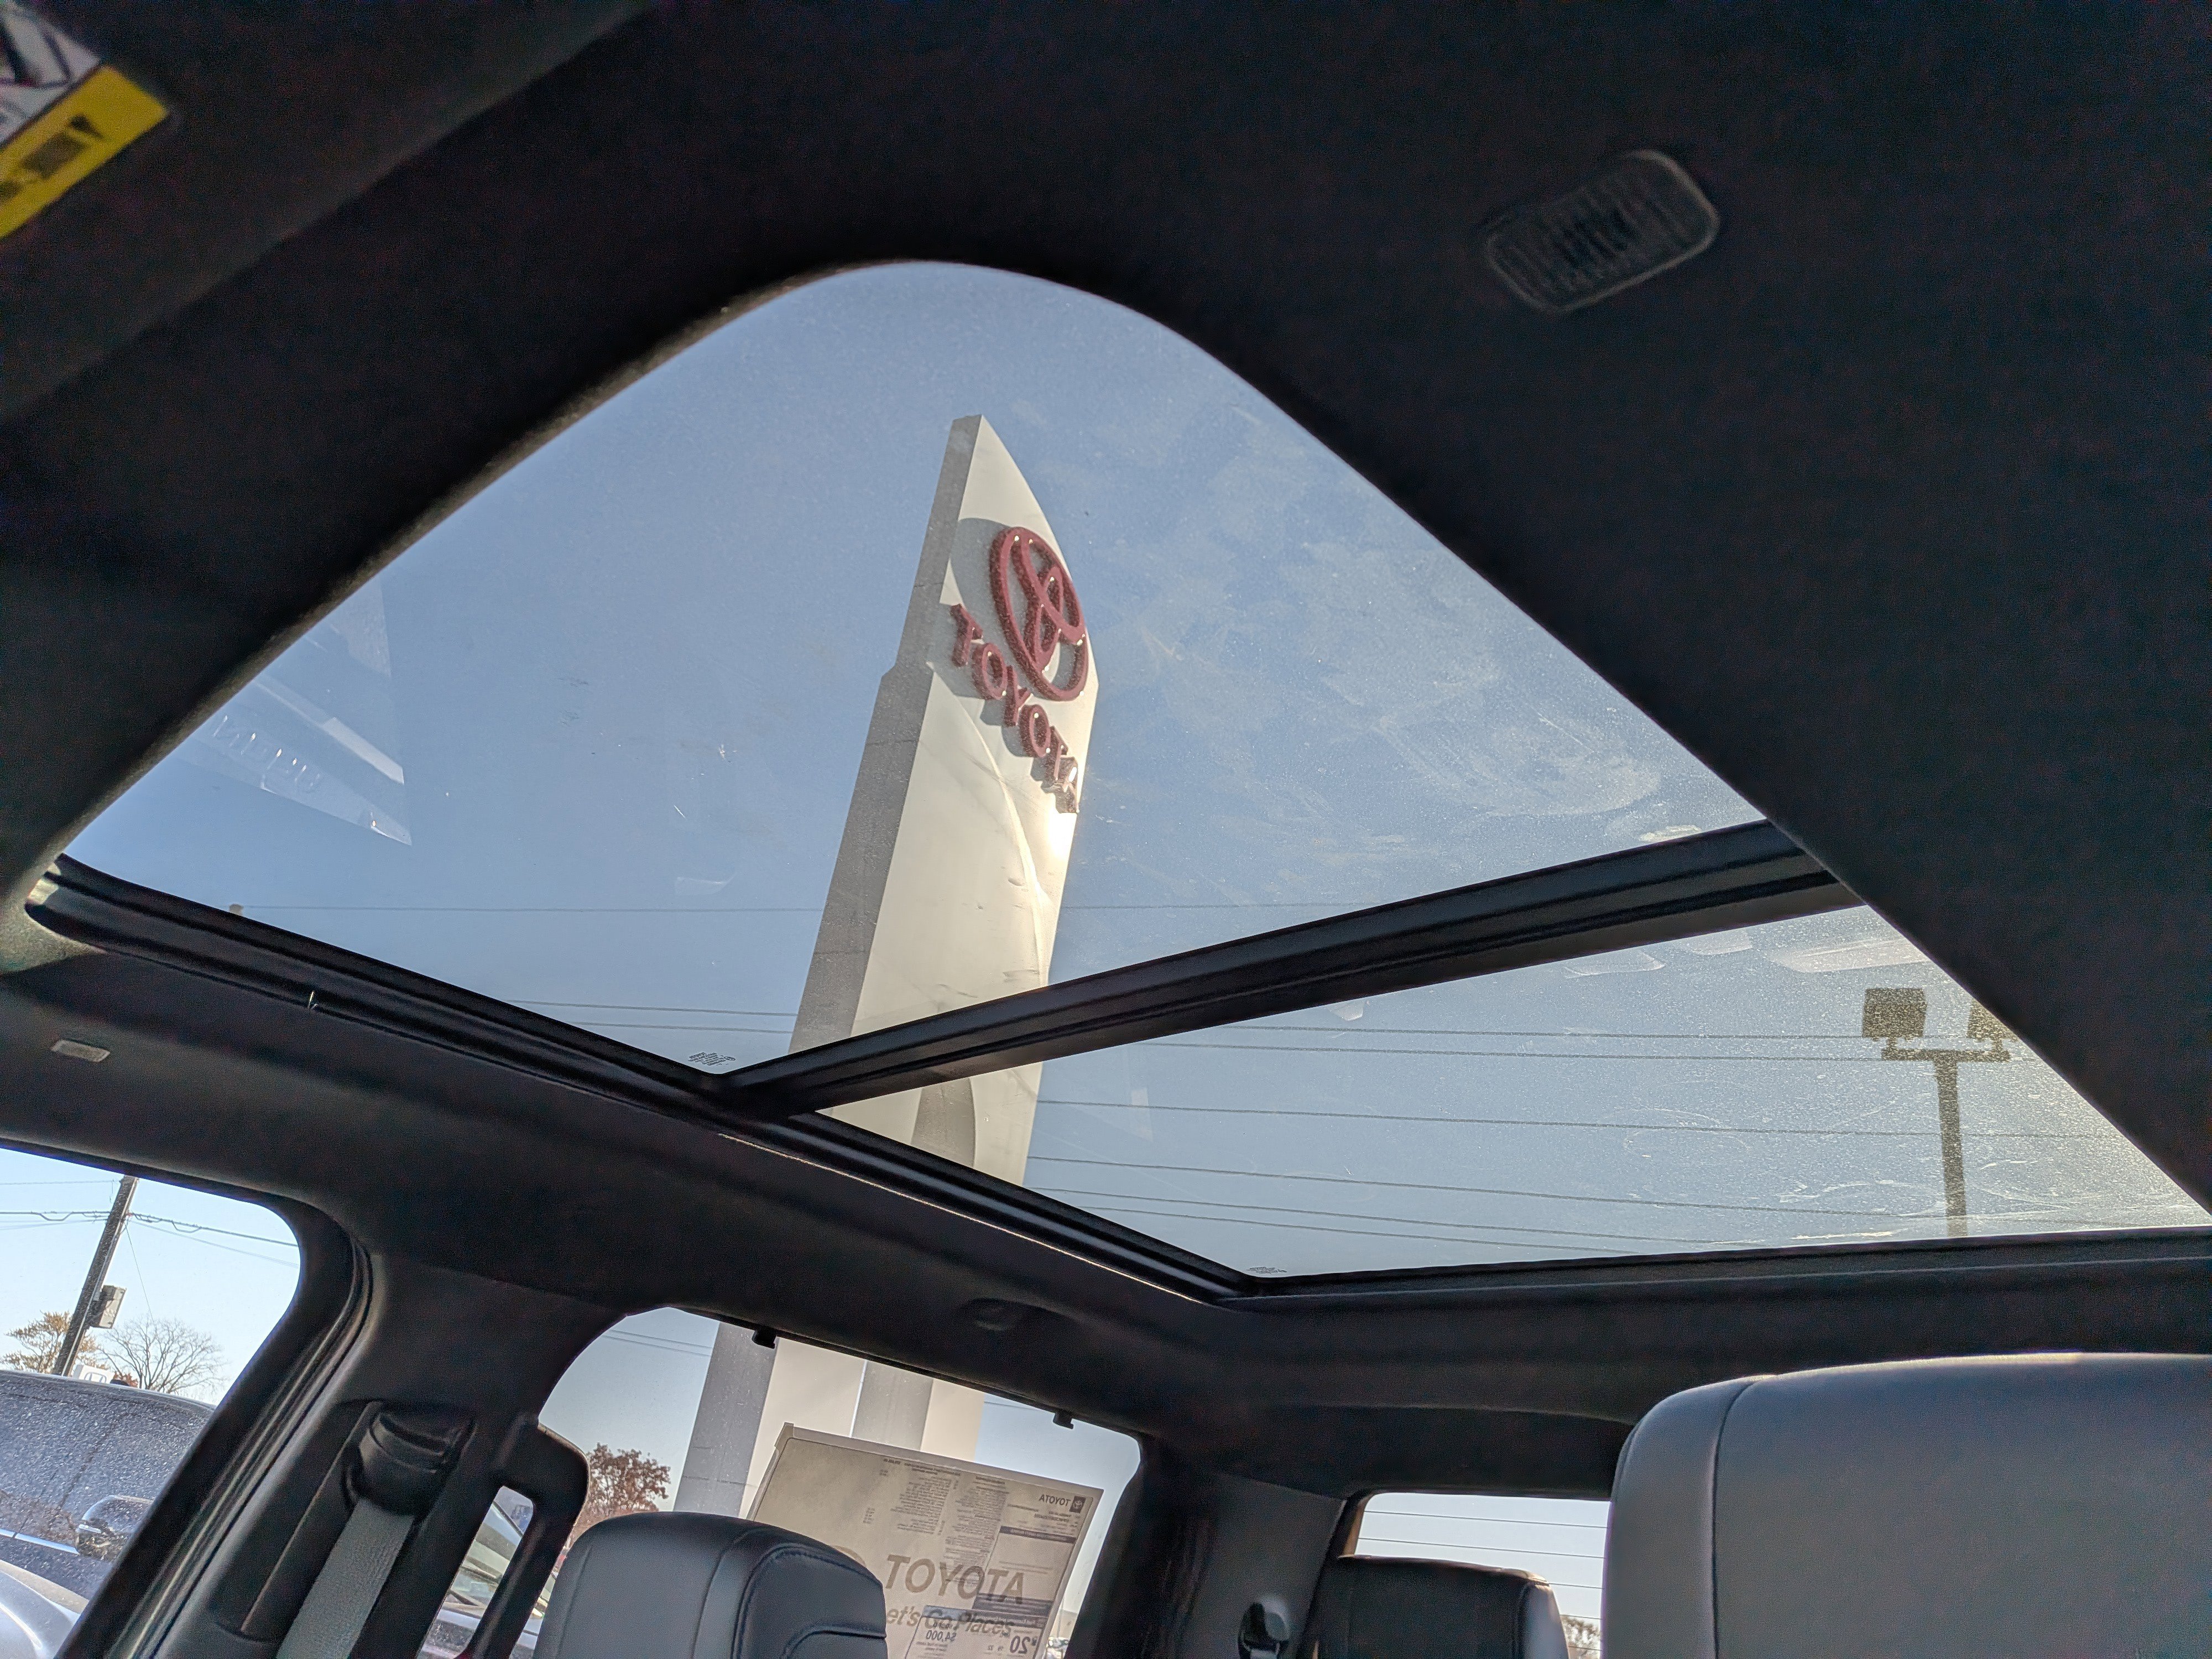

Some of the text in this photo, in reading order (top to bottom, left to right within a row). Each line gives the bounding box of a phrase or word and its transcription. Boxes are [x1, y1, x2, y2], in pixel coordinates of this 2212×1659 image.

[949, 603, 1079, 813] TOYOTA
[885, 1554, 1024, 1604] TOYOTA
[886, 1606, 921, 1627] et's
[954, 1611, 1015, 1635] Places
